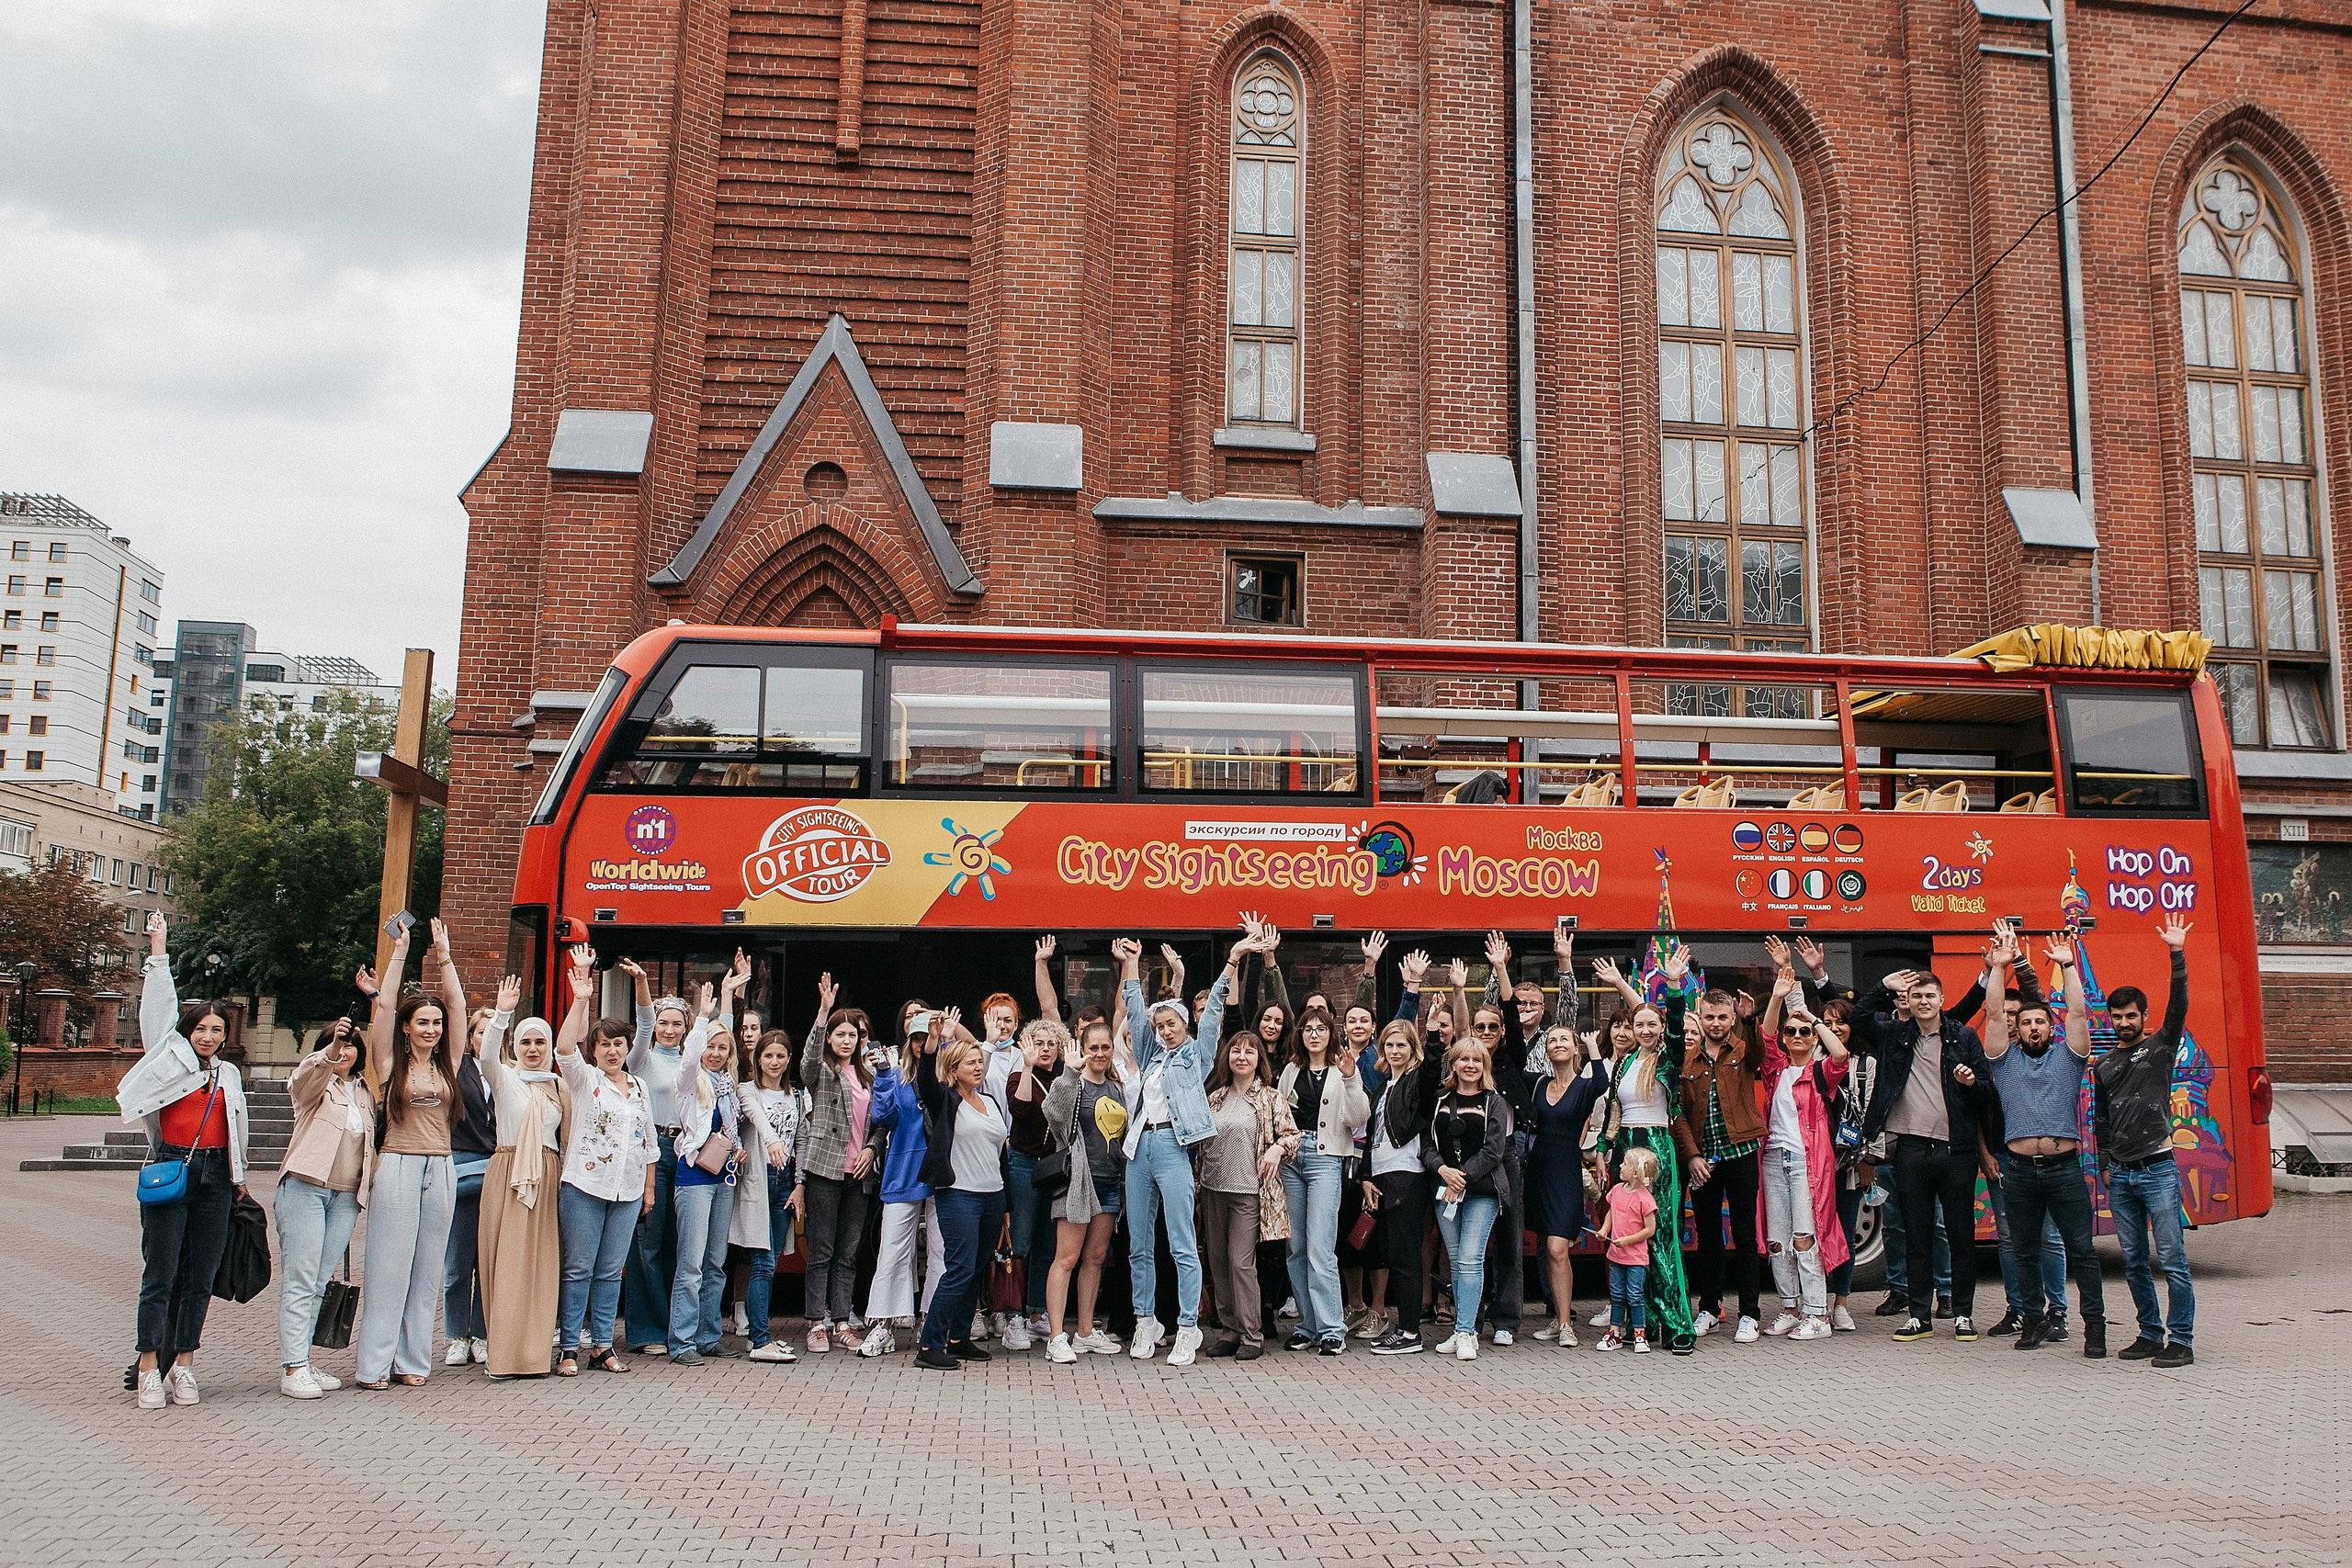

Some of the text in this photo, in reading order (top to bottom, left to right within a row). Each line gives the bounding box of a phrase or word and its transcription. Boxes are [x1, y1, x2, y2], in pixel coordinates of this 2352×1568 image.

[776, 812, 861, 842] CITY SIGHTSEEING
[1189, 825, 1342, 839] экскурсии по городу
[2283, 825, 2305, 837] XIII
[1526, 825, 1603, 852] Москва
[755, 840, 887, 886] OFFICIAL
[1057, 834, 1378, 897] City Sightseeing
[1732, 852, 1765, 862] РУССКИЙ
[1801, 854, 1830, 863] ESPAÑOL
[1834, 855, 1864, 863] DEUTSCH
[2108, 846, 2190, 877] Hop On
[591, 859, 707, 881] Worldwide
[585, 882, 711, 892] OpenTop Sightseeing Tours
[808, 868, 862, 895] TOUR
[1911, 894, 1986, 914] Valid Ticket
[2109, 882, 2196, 912] Hop Off
[1741, 901, 1758, 912] 中文
[1767, 903, 1799, 911] FRANÇAIS
[1842, 1127, 1858, 1138] NOW
